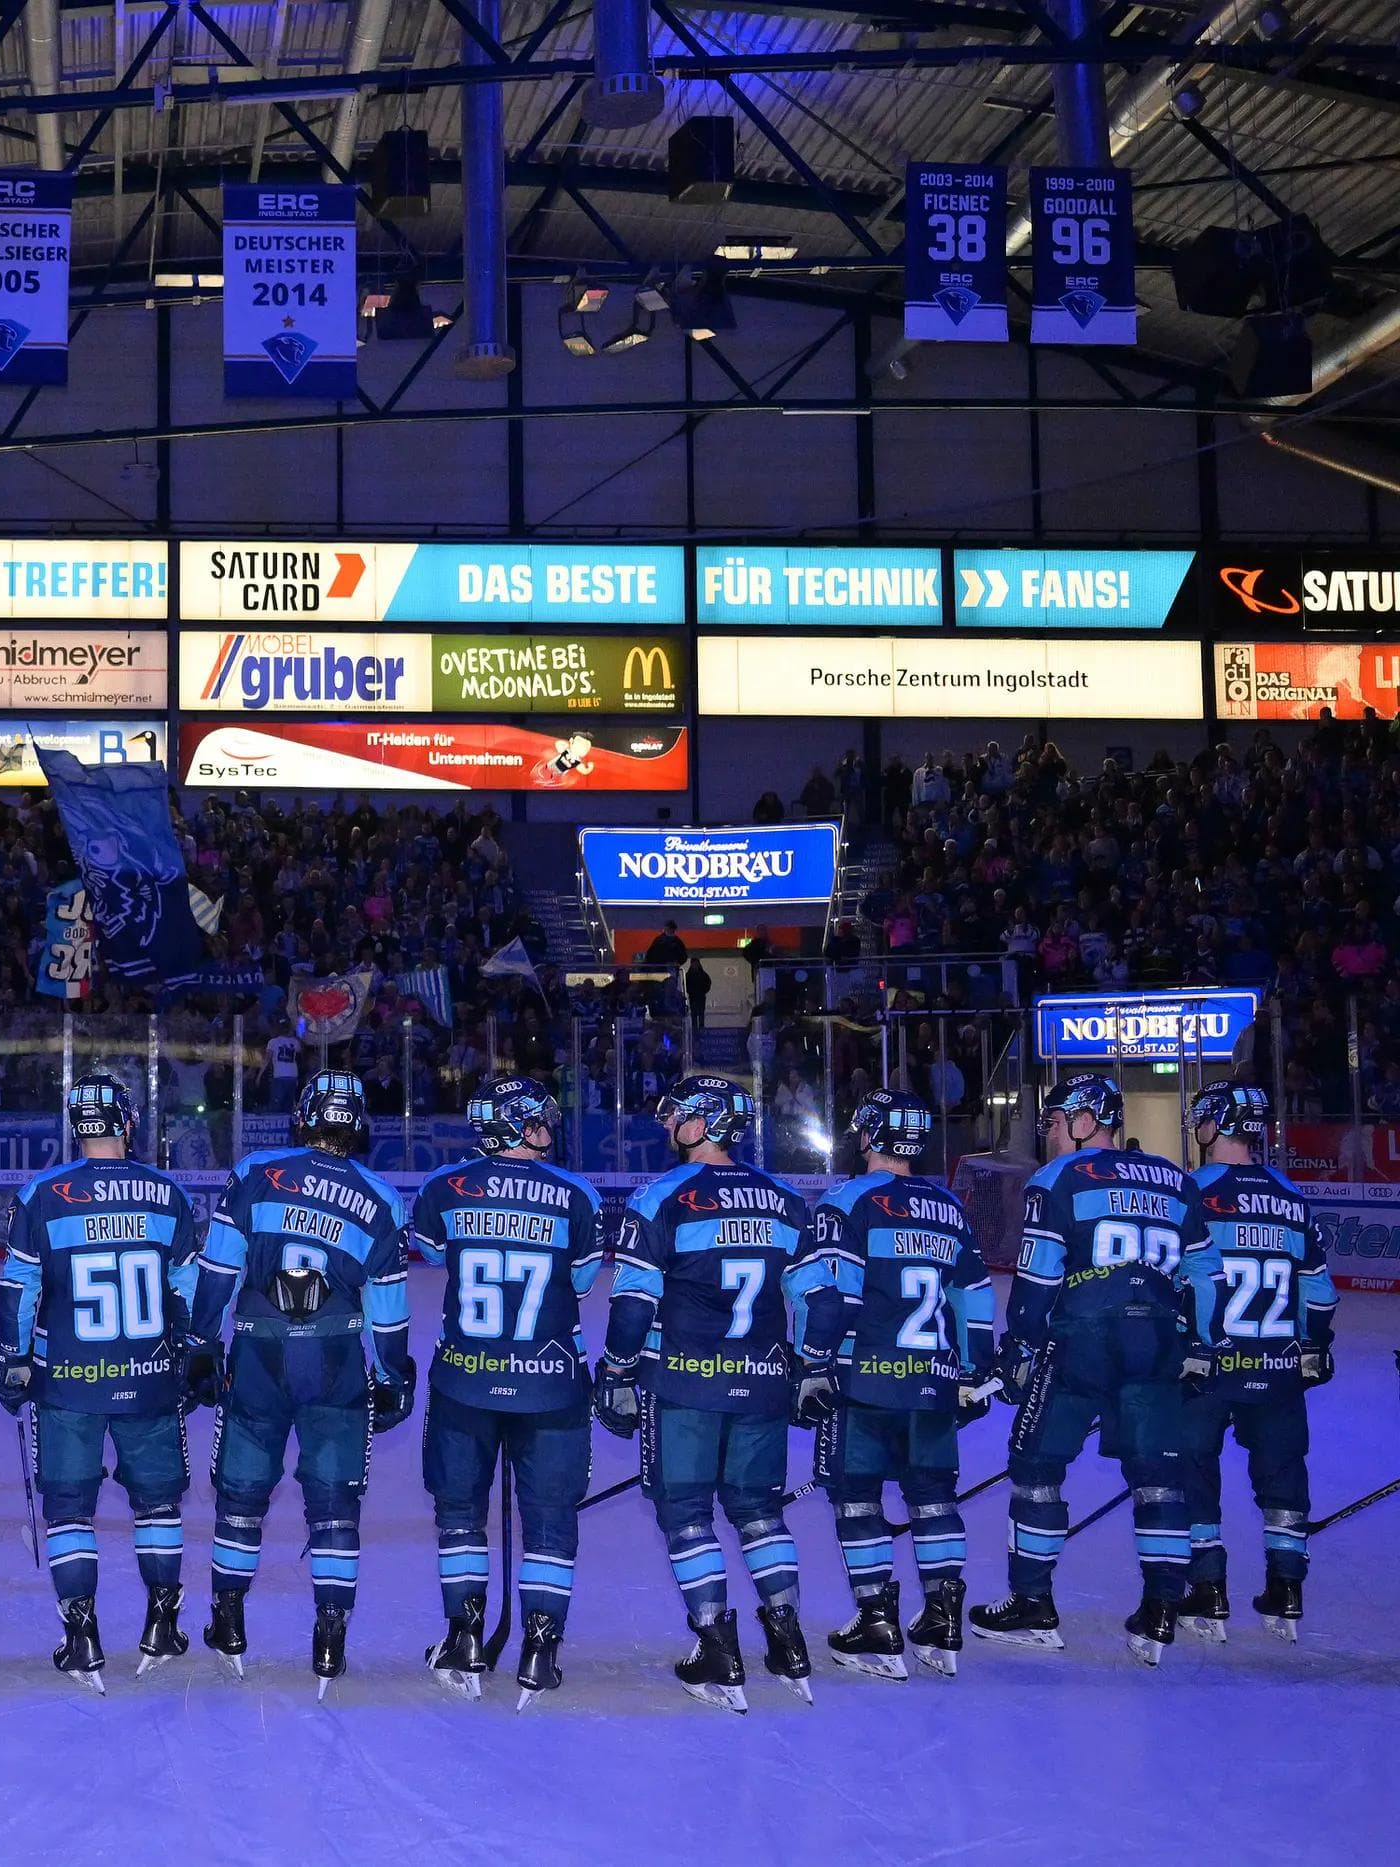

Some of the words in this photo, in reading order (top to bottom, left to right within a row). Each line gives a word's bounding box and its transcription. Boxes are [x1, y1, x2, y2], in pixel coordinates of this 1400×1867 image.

[258, 194, 318, 210] ERC
[924, 194, 990, 212] FICENEC
[1044, 198, 1117, 216] GOODALL
[234, 235, 345, 251] DEUTSCHER
[928, 214, 986, 262] 38
[1052, 218, 1111, 265] 96
[245, 258, 334, 274] MEISTER
[940, 273, 973, 283] ERC
[252, 282, 328, 306] 2014
[1065, 276, 1099, 286] ERC
[3, 561, 166, 597] TREFFER!
[211, 551, 320, 580] SATURN
[458, 564, 533, 603] DAS
[547, 565, 657, 604] BESTE
[704, 557, 772, 605] FÜR
[783, 567, 939, 607] TECHNIK
[1021, 570, 1130, 609] FANS!
[1303, 570, 1400, 612] SATU
[243, 584, 320, 611] CARD
[245, 634, 319, 654] MÖBEL
[14, 674, 67, 685] Abbruch
[241, 647, 404, 709] gruber
[811, 668, 891, 686] Porsche
[896, 669, 980, 687] Zentrum
[987, 670, 1089, 692] Ingolstadt
[1257, 673, 1290, 686] DAS
[1257, 687, 1336, 701] ORIGINAL
[368, 733, 431, 746] IT-Helden
[433, 733, 455, 746] für
[199, 763, 278, 778] SysTec
[429, 752, 523, 766] Unternehmen
[618, 850, 794, 884] NORDBRÄU
[664, 885, 749, 898] INGOLSTADT
[93, 1179, 171, 1206] SATURN
[301, 1174, 378, 1225] SATURN
[486, 1176, 572, 1209] SATURN
[1108, 1190, 1169, 1218] FLAAKE
[1323, 1187, 1350, 1196] Audi
[1237, 1193, 1305, 1222] SATURN
[84, 1214, 147, 1242] BRUNE
[454, 1210, 555, 1244] FRIEDRICH
[715, 1218, 773, 1246] JOBKE
[1236, 1224, 1284, 1250] BODIE
[894, 1231, 956, 1264] SIMPSON
[70, 1250, 164, 1342] 50
[458, 1248, 552, 1341] 67
[1222, 1257, 1295, 1338] 22
[1351, 1278, 1395, 1290] PENNY
[720, 1258, 766, 1339] 7
[52, 1357, 170, 1384] zieglerhaus
[442, 1344, 565, 1374] zieglerhaus
[667, 1351, 784, 1378] zieglerhaus
